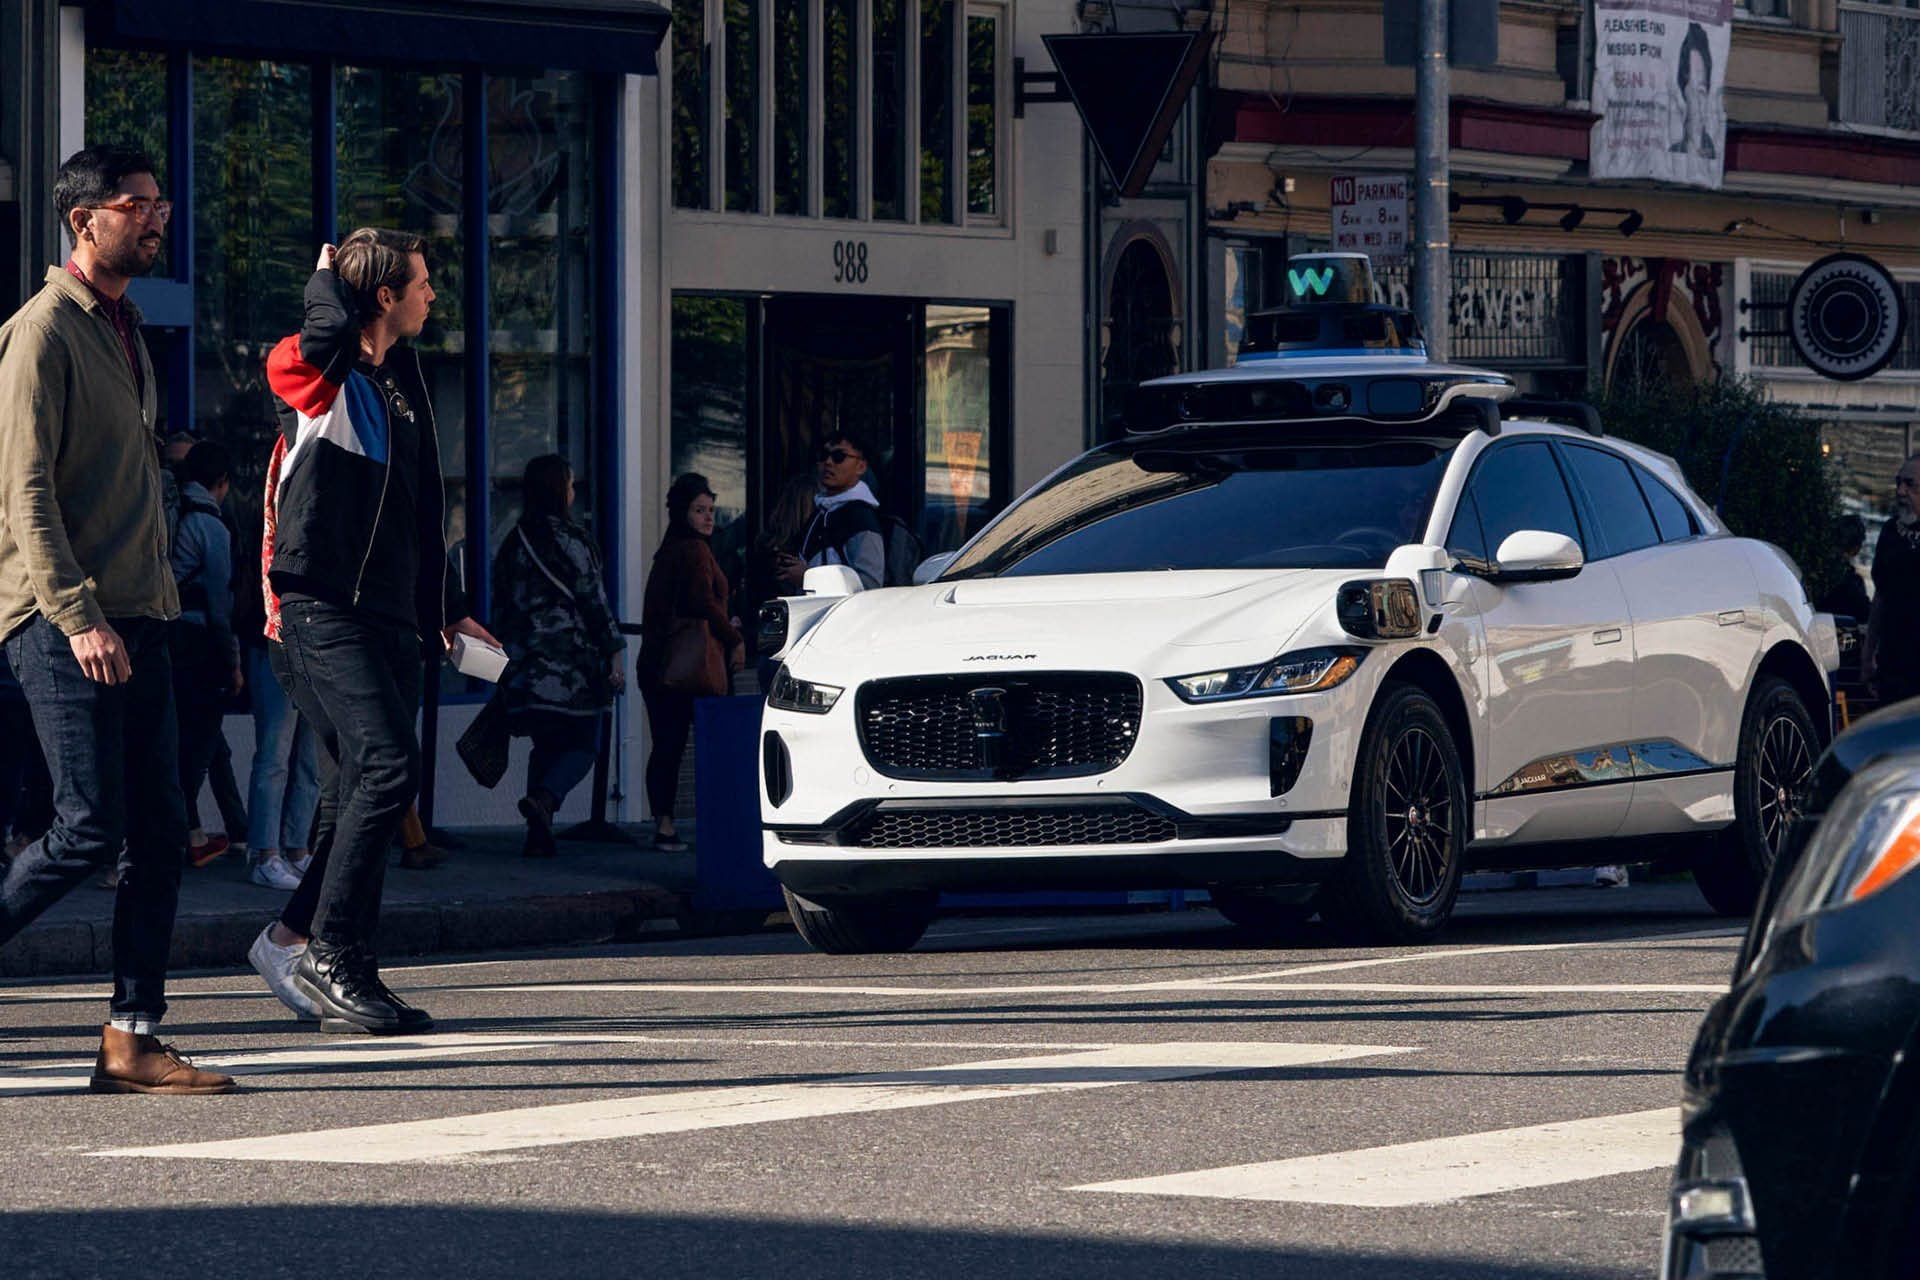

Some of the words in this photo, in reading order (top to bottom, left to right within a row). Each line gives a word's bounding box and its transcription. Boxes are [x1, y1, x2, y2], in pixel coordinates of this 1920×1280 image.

[1333, 179, 1353, 203] NO
[1358, 183, 1405, 201] PARKING
[1338, 232, 1357, 247] MON
[1364, 232, 1382, 246] WED
[1388, 231, 1402, 245] FRI
[834, 240, 868, 283] 988
[1460, 284, 1546, 329] awer
[1520, 774, 1546, 785] JAGUAR
